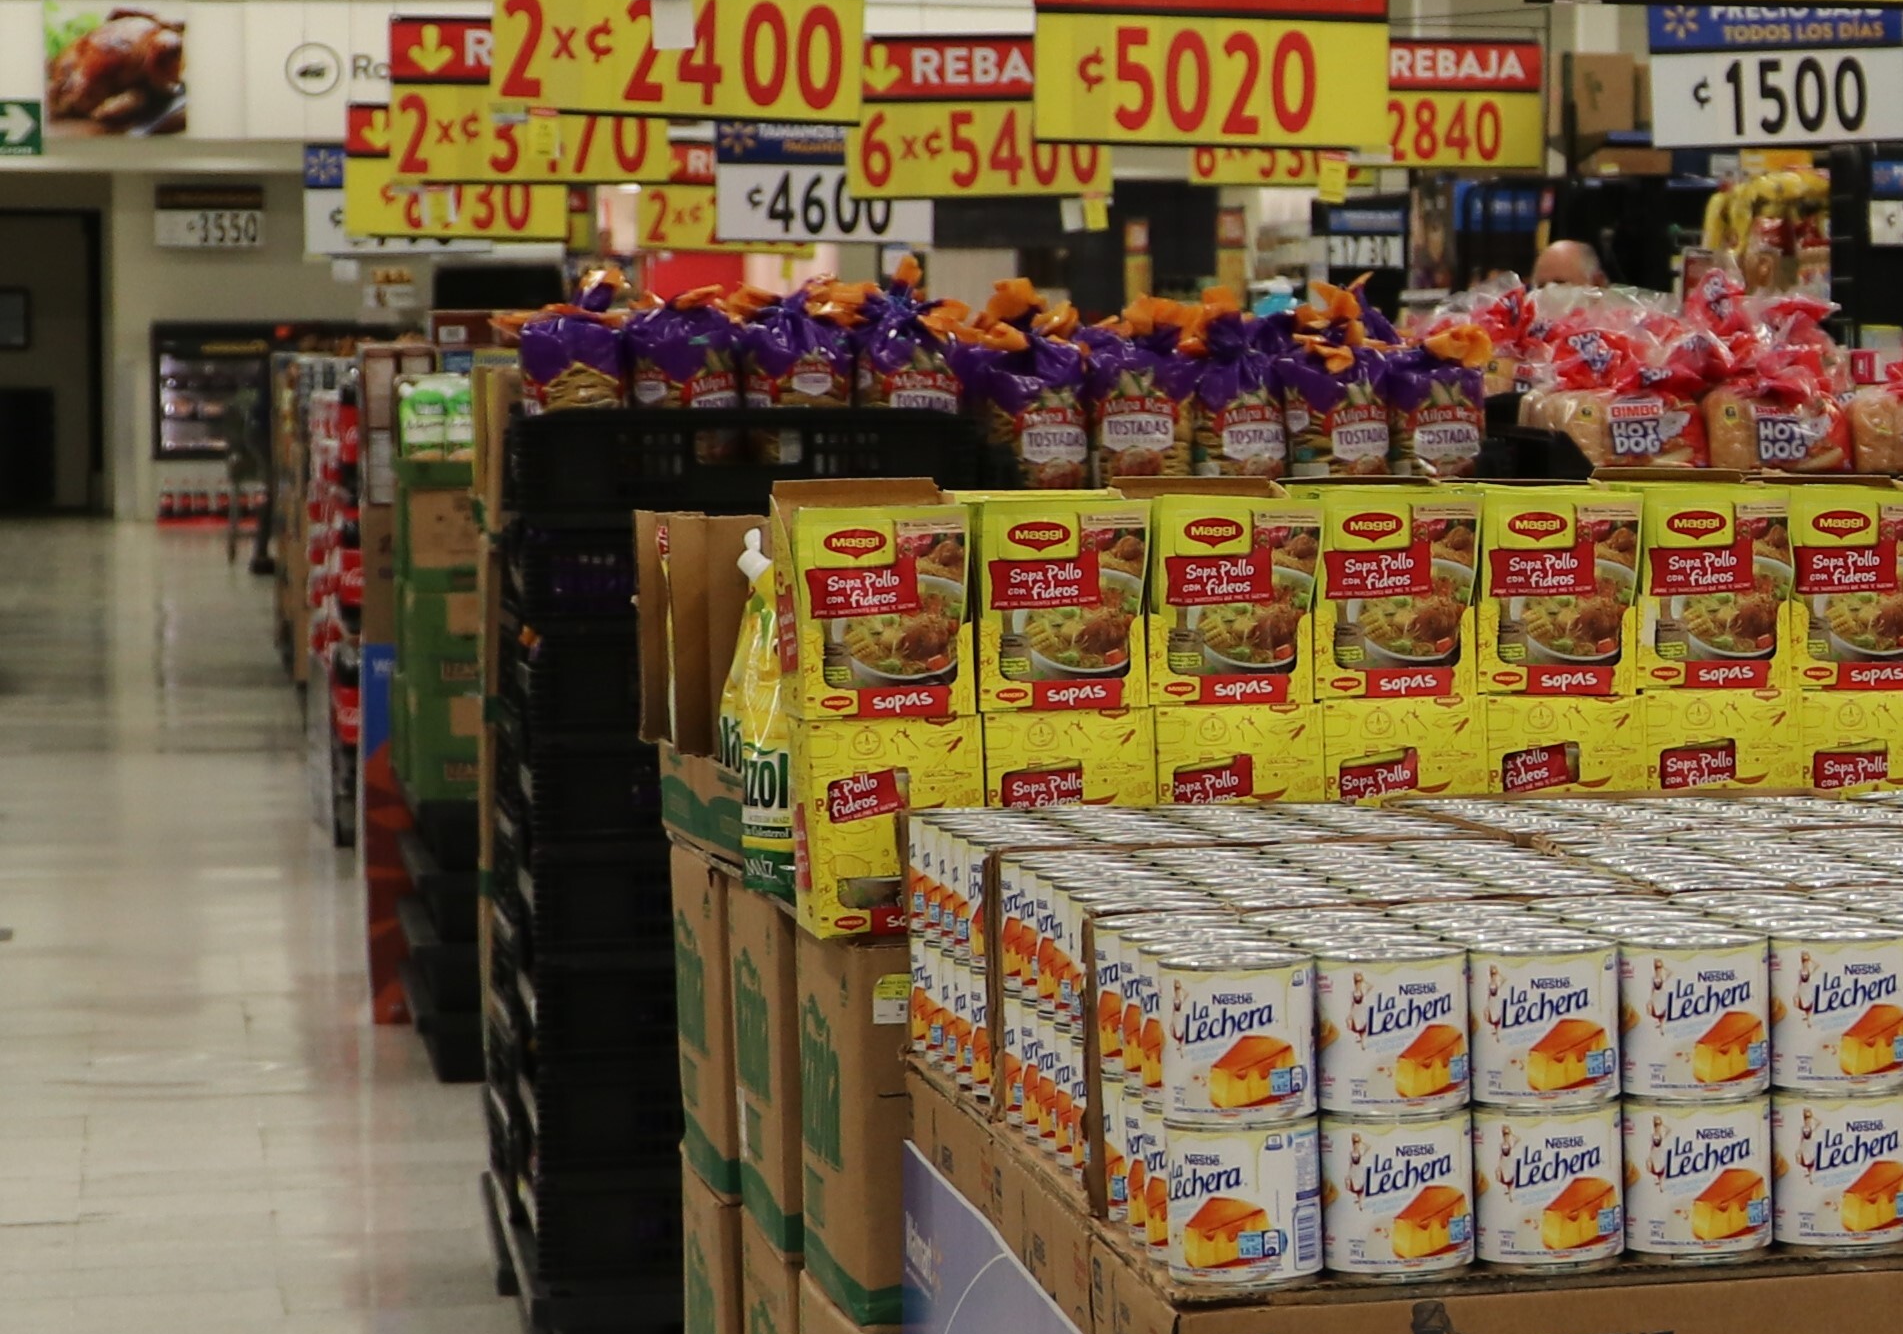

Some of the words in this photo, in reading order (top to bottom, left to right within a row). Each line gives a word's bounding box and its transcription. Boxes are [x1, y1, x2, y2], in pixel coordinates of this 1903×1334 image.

[1724, 26, 1791, 42] TODOS
[1797, 24, 1833, 40] LOS
[911, 47, 1034, 84] REBA
[1391, 47, 1525, 81] REBAJA
[1107, 418, 1169, 436] TOSTADAS
[1613, 421, 1658, 440] HOT
[1614, 437, 1661, 455] DOG
[832, 534, 880, 550] Maggi
[827, 575, 862, 593] Sopa
[865, 570, 900, 588] Pollo
[826, 594, 847, 606] con
[850, 590, 897, 608] fideos
[873, 690, 933, 712] sopas
[1212, 993, 1254, 1005] Nestlé
[1192, 1001, 1209, 1020] La
[1185, 1005, 1273, 1045] Lechera
